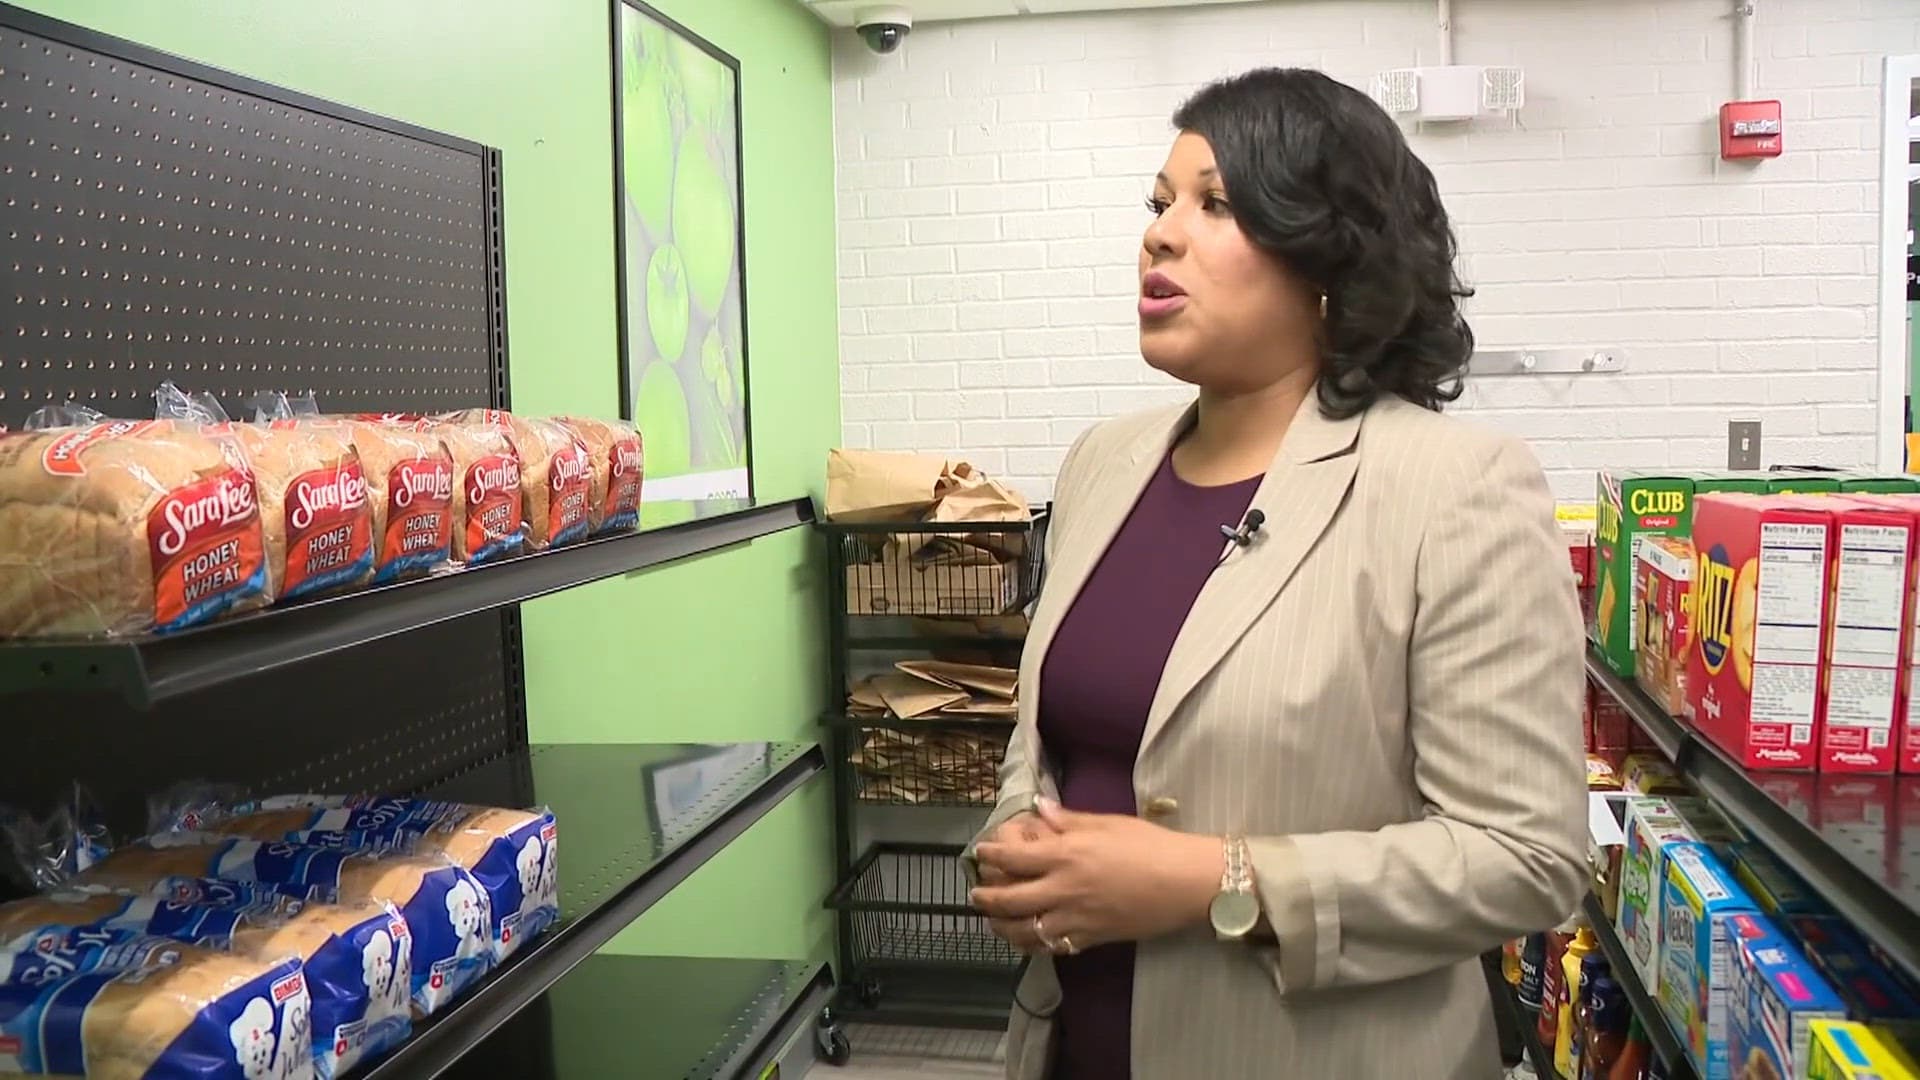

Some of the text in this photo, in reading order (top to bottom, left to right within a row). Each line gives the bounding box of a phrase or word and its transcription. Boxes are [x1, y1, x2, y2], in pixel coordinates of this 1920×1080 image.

[395, 465, 452, 507] Sara Lee
[470, 459, 520, 504] Sara Lee
[159, 479, 257, 555] Sara Lee
[292, 472, 366, 529] Sara Lee
[481, 503, 512, 524] HONEY
[1631, 489, 1685, 515] CLUB
[308, 525, 353, 555] HONEY
[405, 512, 441, 532] HONEY
[1764, 525, 1824, 535] Nutrition Facts
[306, 544, 351, 574] WHEAT
[403, 532, 439, 551] WHEAT
[183, 539, 240, 582] HONEY
[184, 561, 240, 603] WHEAT
[1697, 551, 1736, 650] RITZ
